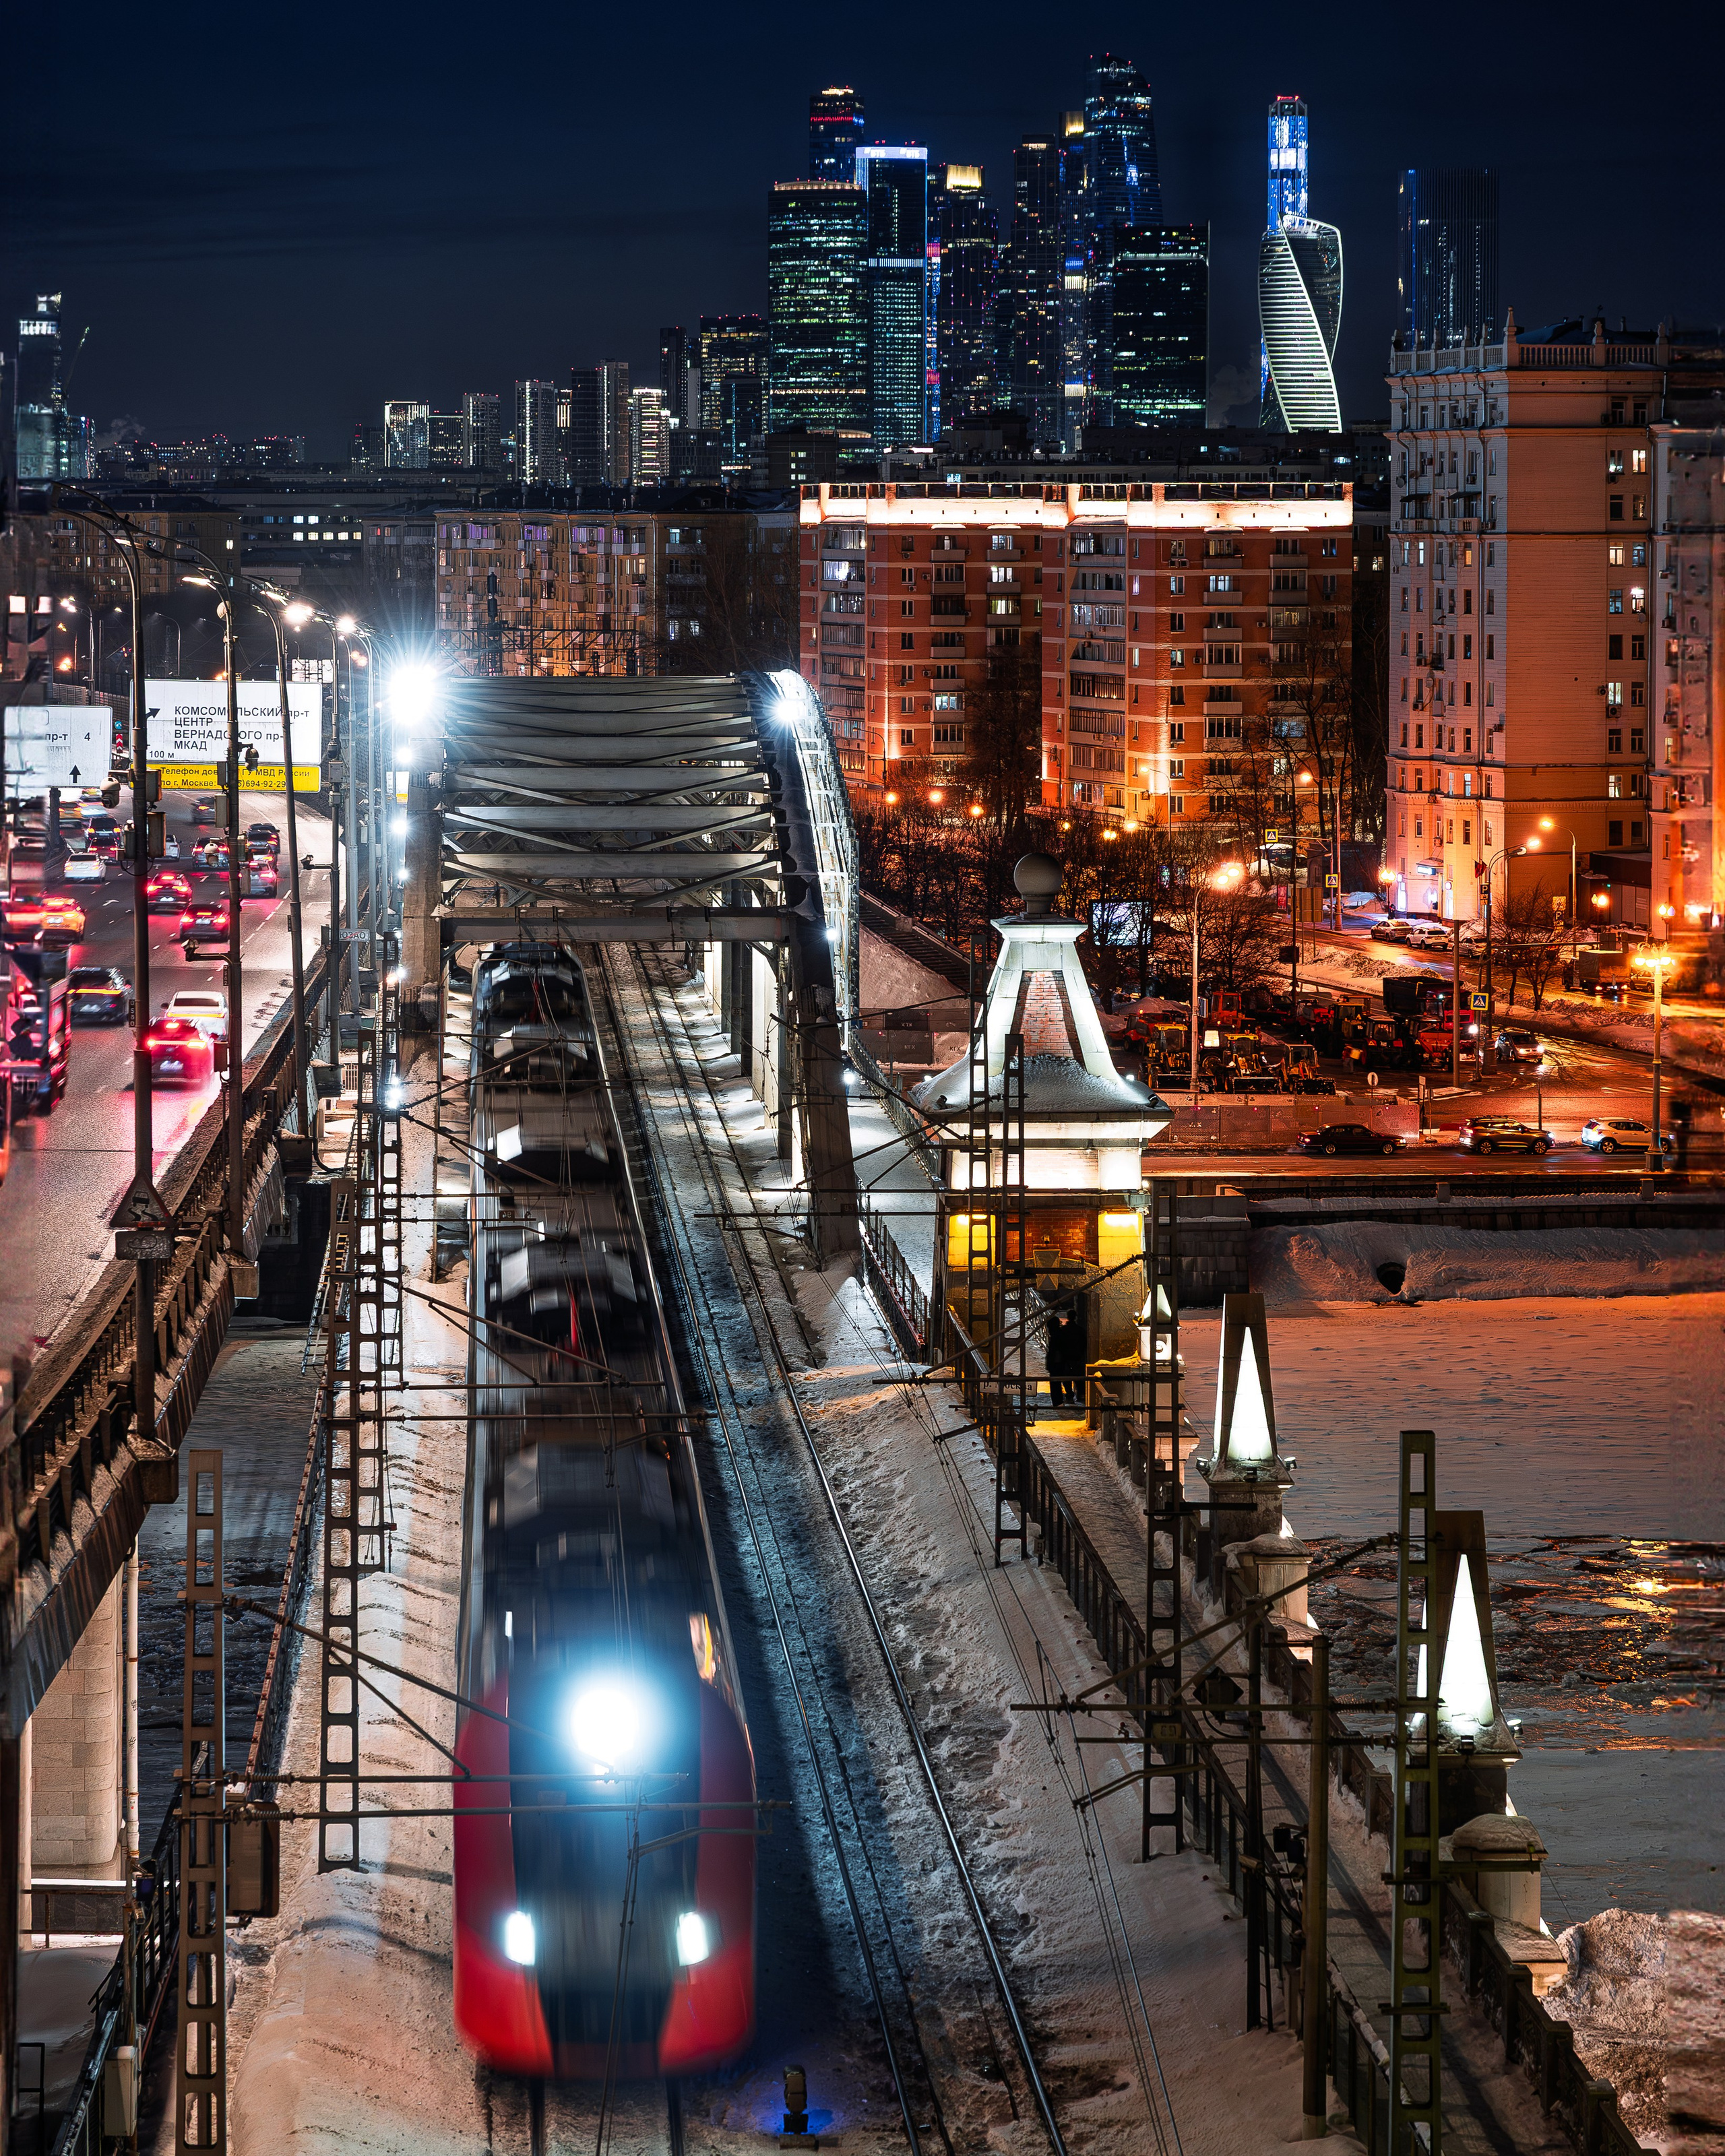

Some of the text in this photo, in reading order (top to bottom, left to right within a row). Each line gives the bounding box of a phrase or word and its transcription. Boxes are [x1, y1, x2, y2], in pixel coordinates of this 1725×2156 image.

[175, 706, 282, 717] КОМСОМЛЬСКИЙ
[175, 717, 214, 728] ЦЕНТР
[84, 732, 91, 741] 4
[175, 730, 262, 740] ВЕРНАДСОГО
[174, 740, 208, 752] МКАД
[160, 767, 199, 776] Телефон
[256, 769, 276, 777] МВД
[181, 779, 216, 787] Москве:
[1482, 885, 1488, 893] P
